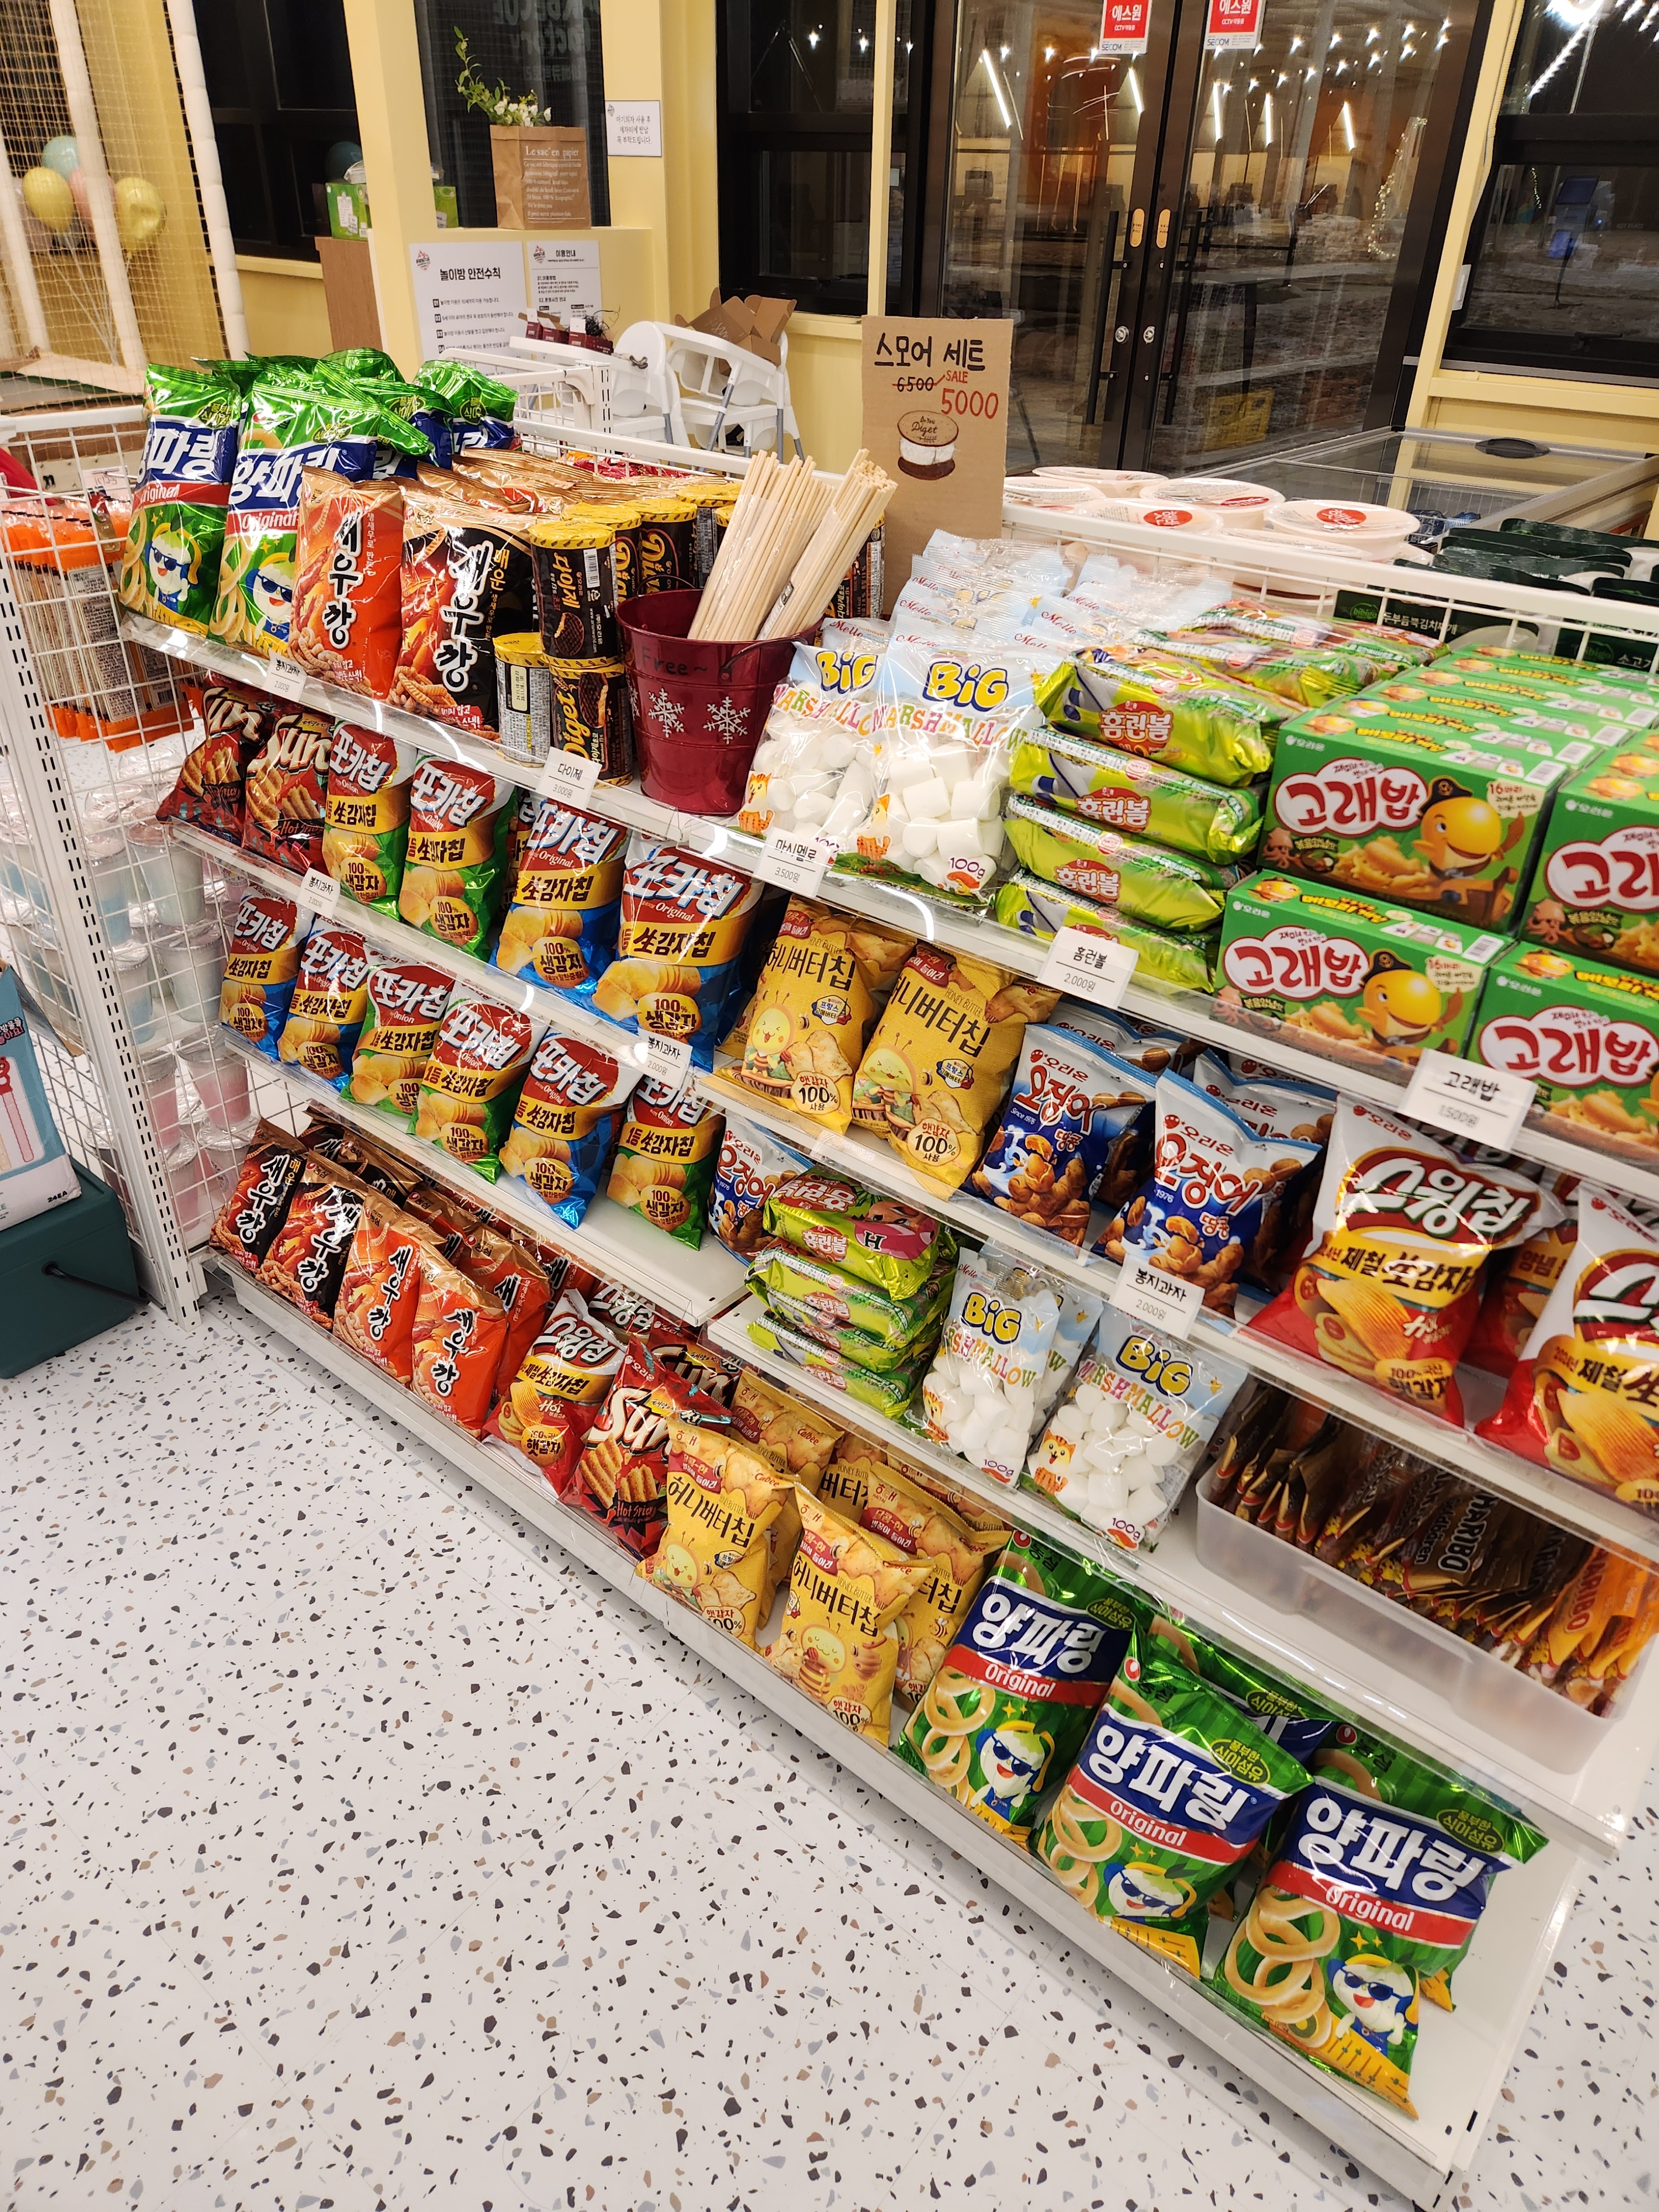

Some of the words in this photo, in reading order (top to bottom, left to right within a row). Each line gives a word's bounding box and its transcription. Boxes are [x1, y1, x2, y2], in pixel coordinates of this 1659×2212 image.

[1112, 4, 1142, 22] 에스원
[1219, 0, 1252, 15] 에스원
[526, 146, 536, 155] Le
[563, 149, 578, 159] papier
[440, 269, 466, 281] 놀이방
[468, 267, 501, 279] 안전수칙
[874, 332, 932, 367] 스모어
[943, 338, 985, 371] 세트
[897, 376, 933, 392] 6500
[946, 370, 968, 384] SALE
[941, 388, 999, 419] 5000
[911, 421, 938, 434] Diget
[322, 509, 366, 649] 새우깡
[493, 548, 509, 591] 매운
[552, 552, 581, 608] 다이제
[434, 541, 494, 692] 새우깡
[1353, 607, 1378, 620] bibigo
[831, 620, 863, 638] Mello
[276, 659, 300, 677] 봉지과자
[640, 645, 688, 676] Free
[1099, 711, 1173, 743] 홈런볼
[330, 729, 392, 794] 포카칩
[558, 763, 583, 781] 다이제
[410, 763, 486, 827] 포카칩
[1286, 776, 1420, 827] 고래밥
[1076, 797, 1151, 823] 홈런볼
[526, 803, 620, 865] 포카칩
[776, 838, 817, 863] 마시멜로
[949, 857, 986, 880] 100g
[310, 876, 333, 895] 봉지과자
[345, 874, 379, 891] 생감자
[623, 854, 744, 919] 포카칩
[1055, 868, 1120, 898] 홈런볼
[234, 902, 289, 952] 포카칩
[434, 912, 470, 932] 생감자
[764, 944, 855, 991] 허니버터칩
[1072, 946, 1108, 970] 홈런볼
[1235, 945, 1361, 988] 고래밥
[816, 1008, 836, 1019] 고메버터
[821, 1001, 839, 1011] 프랑스
[962, 1000, 982, 1016] BUTTER
[233, 1017, 263, 1031] 생감자
[394, 1011, 415, 1025] Onion
[648, 1036, 681, 1060] 봉지과자
[1495, 1023, 1652, 1077] 고래밥
[304, 1053, 339, 1068] 생감자
[461, 1051, 482, 1070] Onion
[945, 1062, 964, 1075] 프랑스
[423, 1066, 441, 1084] 1등
[799, 1076, 828, 1089] 햇감자
[941, 1070, 961, 1084] 고메버터
[1443, 1071, 1501, 1102] 고래밥
[800, 1088, 838, 1105] 100%
[810, 1102, 825, 1113] 사용
[1014, 1065, 1107, 1133] 오징어
[658, 1111, 674, 1127] Onion
[1010, 1107, 1025, 1119] Since
[1023, 1114, 1036, 1125] 1976
[625, 1126, 643, 1146] 1등
[922, 1123, 950, 1138] 햇감자
[1054, 1129, 1084, 1152] 땅콩
[447, 1136, 484, 1154] 생감자
[923, 1152, 940, 1162] 사용
[285, 1159, 300, 1186] 매운
[529, 1173, 568, 1192] 생감자
[717, 1145, 775, 1208] 오징어
[1155, 1133, 1262, 1214] 오징어
[48, 1191, 67, 1203] 24EA
[236, 1154, 290, 1244] 새우깡
[1156, 1188, 1175, 1204] 1976
[1334, 1158, 1530, 1238] 스윙칩
[645, 1199, 685, 1218] 생감자
[1199, 1212, 1231, 1240] 땅콩
[803, 1230, 848, 1258] 홈런볼
[863, 1231, 886, 1251] H
[957, 1263, 977, 1279] Mello
[1341, 1248, 1387, 1277] 제철
[367, 1245, 412, 1341] 새우깡
[1135, 1267, 1187, 1302] 봉지과자
[431, 1308, 474, 1396] 새우깡
[534, 1318, 615, 1366] 스윙칩
[525, 1363, 541, 1380] 제철
[1578, 1358, 1627, 1393] 제철
[742, 1387, 758, 1400] 해태
[1077, 1359, 1199, 1450] MARSHMALLOW
[527, 1439, 561, 1457] 햇감자
[676, 1430, 697, 1446] 해태
[797, 1426, 820, 1447] Calbee
[983, 1458, 1014, 1477] 100g
[875, 1483, 897, 1501] 해태
[617, 1502, 632, 1517] Hot
[633, 1505, 657, 1519] Spicy
[668, 1476, 755, 1548] 허니버터칩
[891, 1530, 912, 1548] 들어간
[1112, 1517, 1141, 1541] 100g
[1438, 1491, 1499, 1574] HARIBO
[793, 1554, 879, 1637] 허니버터칩
[837, 1575, 854, 1592] HONEY
[853, 1584, 874, 1603] BUTTER
[706, 1608, 734, 1619] 햇감자
[971, 1593, 1106, 1675] 양파링
[833, 1698, 863, 1713] 햇감자
[1214, 1747, 1269, 1783] 식이섬유
[1088, 1724, 1250, 1831] 양파링
[1109, 1802, 1188, 1848] Original
[1442, 1814, 1498, 1851] 식이섬유
[1297, 1797, 1487, 1902] 양파링
